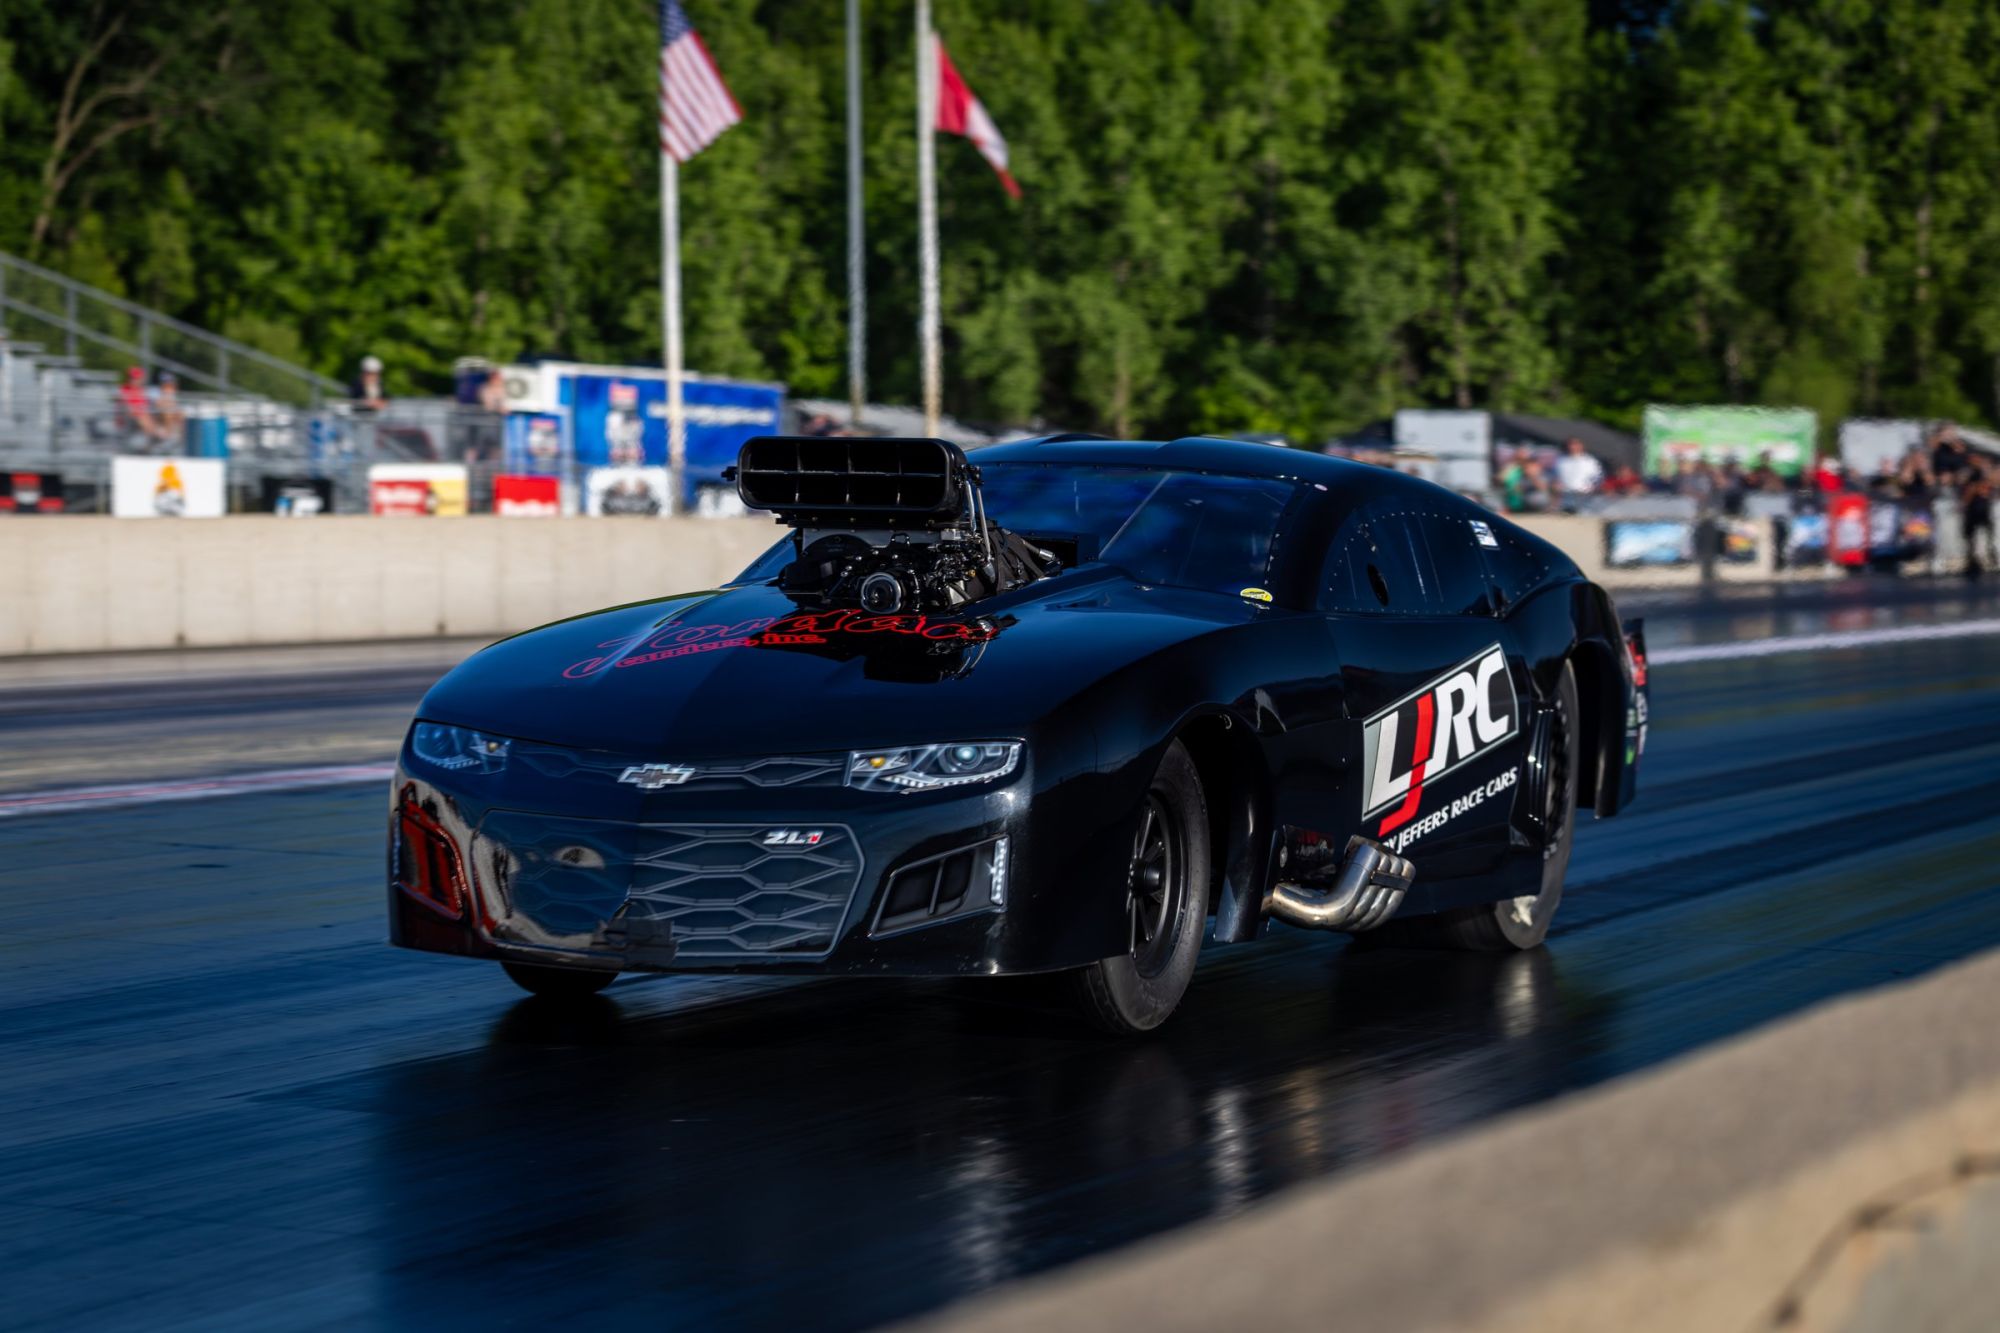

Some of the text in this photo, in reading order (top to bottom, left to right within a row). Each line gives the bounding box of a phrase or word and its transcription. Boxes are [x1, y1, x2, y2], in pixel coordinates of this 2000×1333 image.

[1396, 805, 1450, 855] JEFFERS
[1450, 786, 1485, 819] RACE
[1486, 766, 1518, 798] CARS
[762, 830, 824, 845] ZL1
